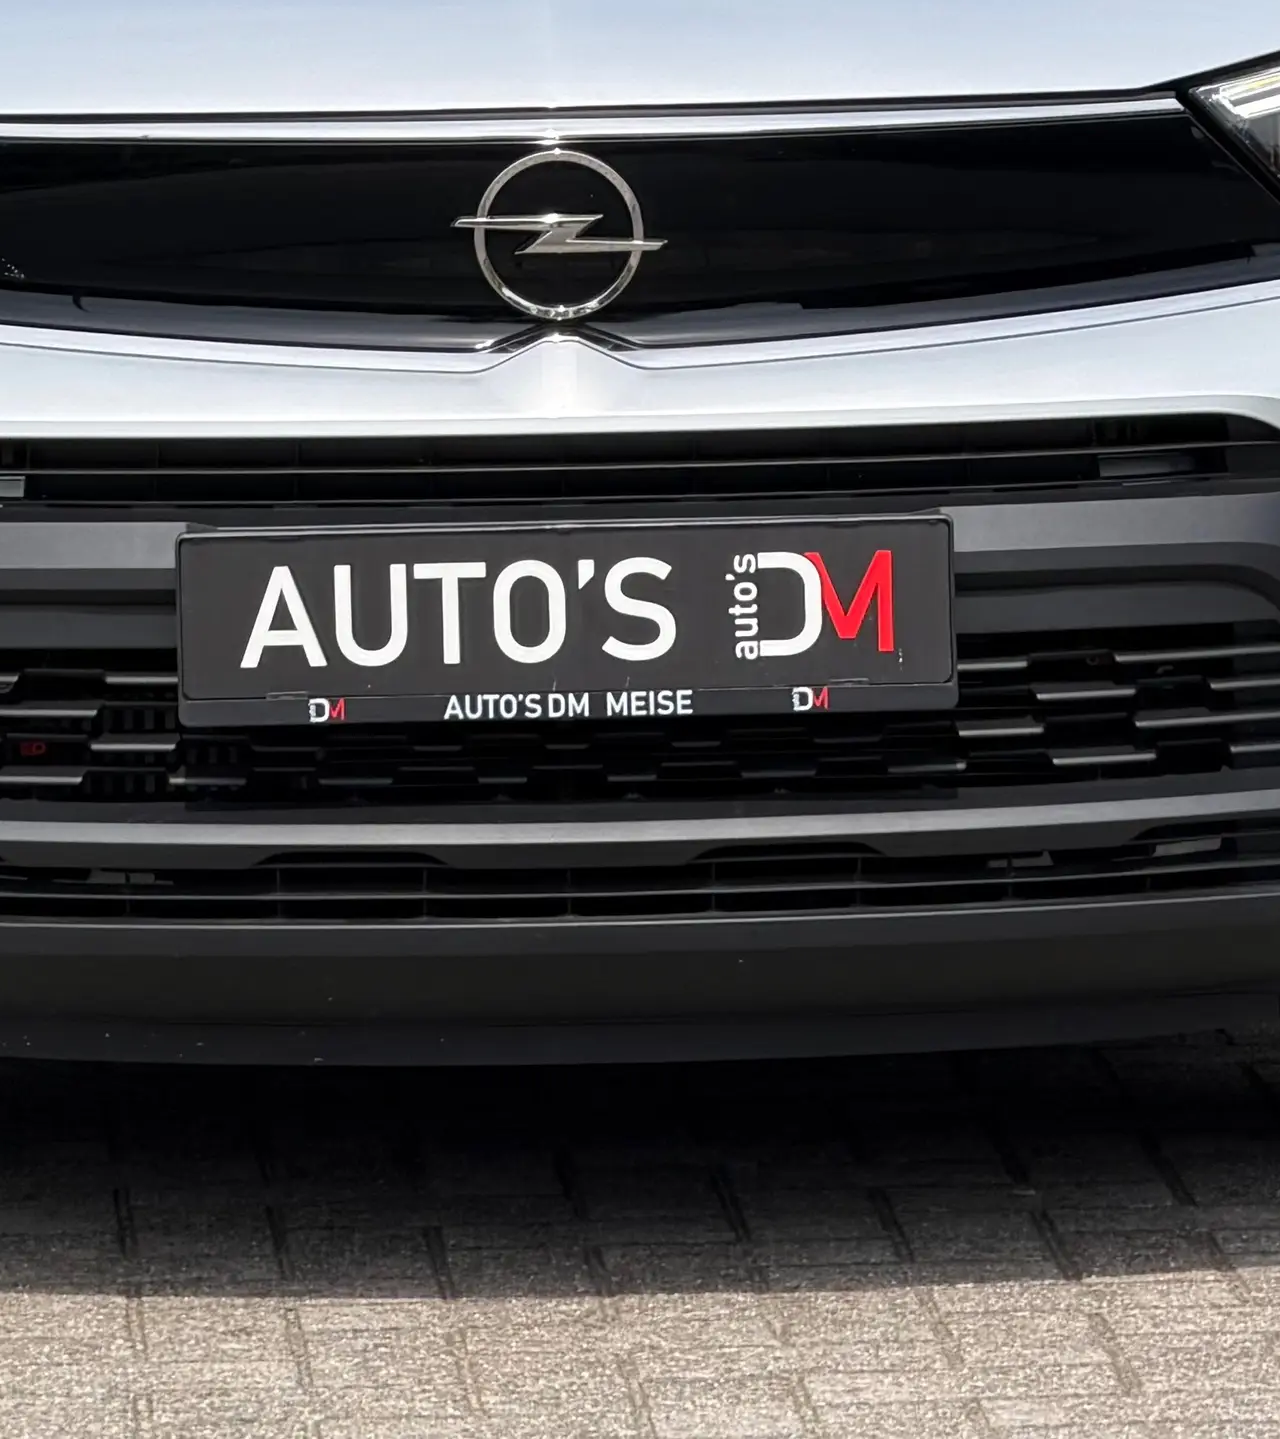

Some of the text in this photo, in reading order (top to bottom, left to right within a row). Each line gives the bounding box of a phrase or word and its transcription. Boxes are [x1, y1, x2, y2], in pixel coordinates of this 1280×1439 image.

[239, 557, 677, 668] AUTO'S
[725, 553, 758, 660] auto's
[757, 549, 894, 657] DM
[443, 689, 694, 720] AUTO'S DM MEISE
